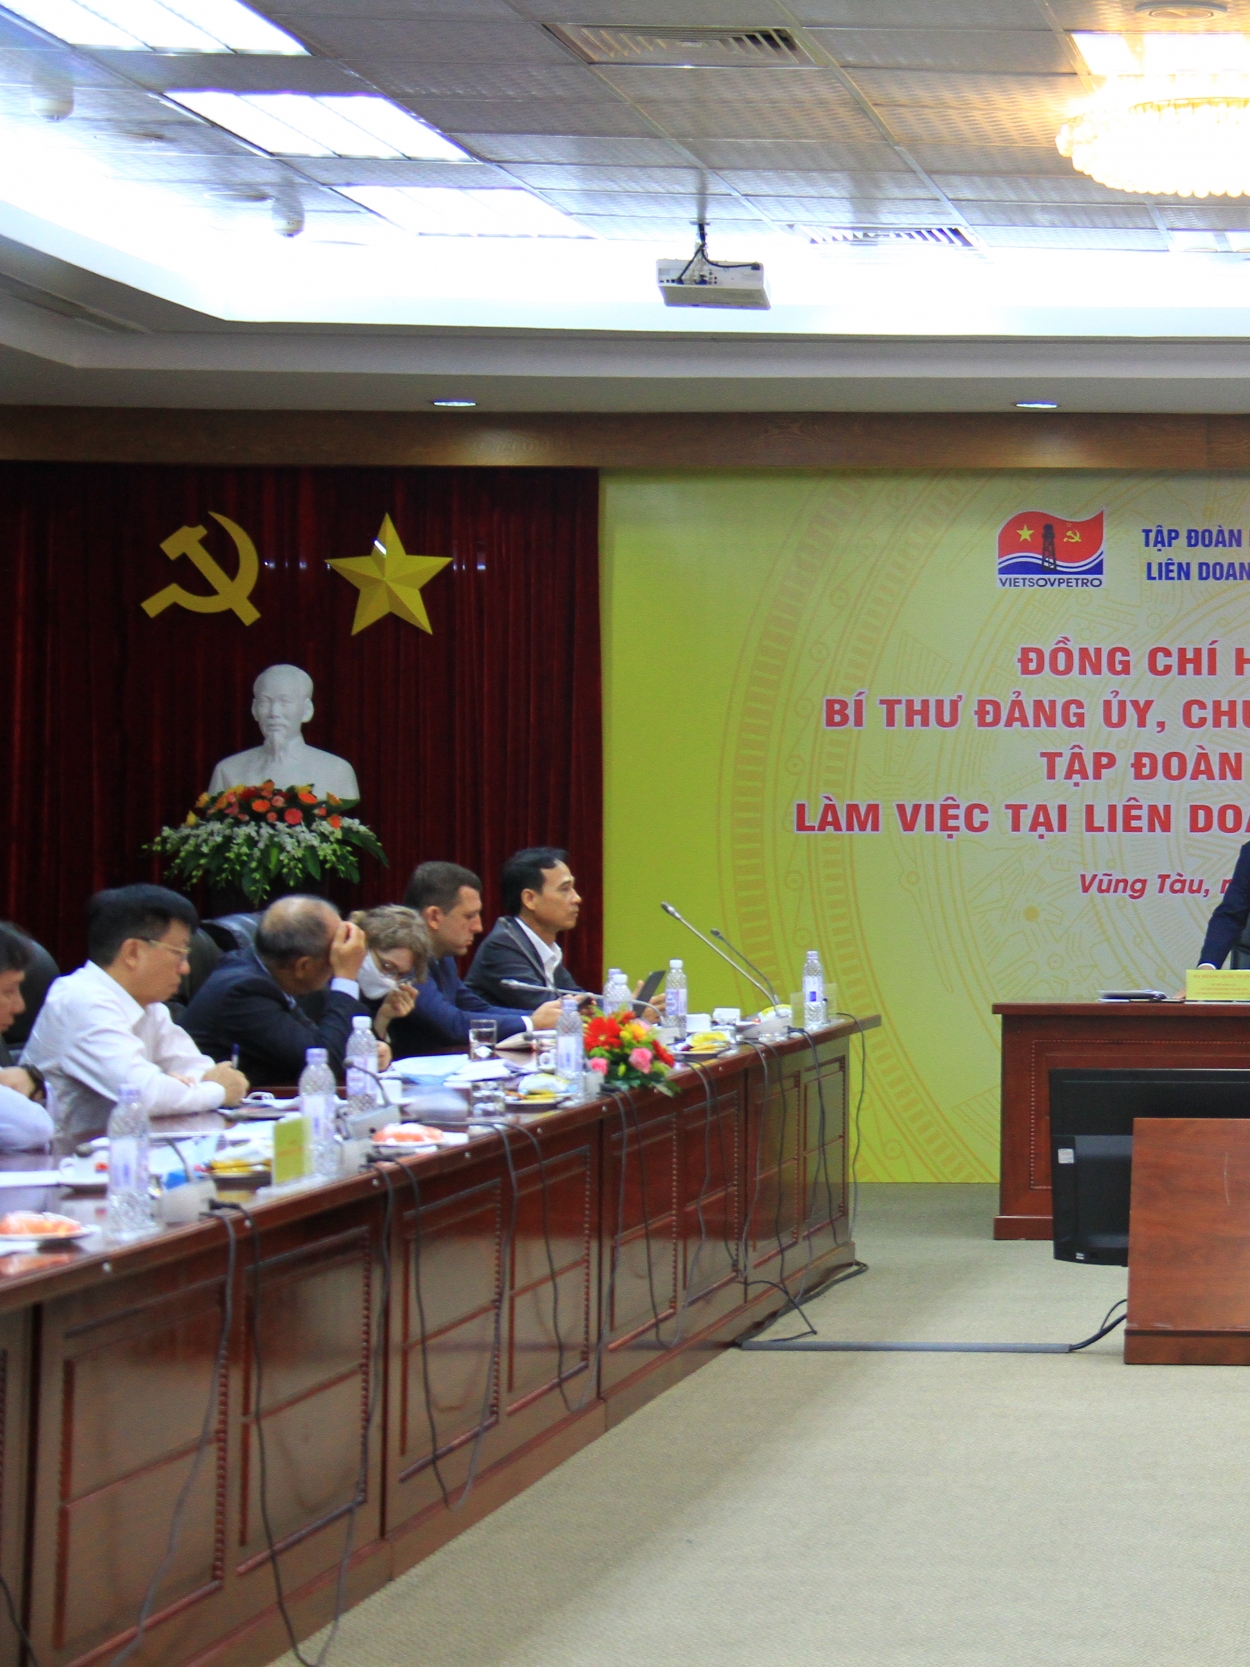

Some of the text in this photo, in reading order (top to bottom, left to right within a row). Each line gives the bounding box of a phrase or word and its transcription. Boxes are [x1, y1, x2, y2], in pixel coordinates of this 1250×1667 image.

[1142, 525, 1180, 552] TẬP
[1186, 524, 1242, 548] ĐOÀN
[999, 577, 1103, 588] VIETSOVPETRO
[1146, 558, 1191, 581] LIÊN
[1018, 636, 1130, 676] ĐỒNG
[1148, 640, 1217, 676] CHÍ
[825, 691, 864, 728] BÍ
[880, 695, 962, 728] THƯ
[975, 691, 1085, 728] ĐẢNG
[1103, 690, 1166, 733] ỦY,
[1041, 745, 1117, 787] TẬP
[1131, 745, 1242, 780] ĐOÀN
[796, 795, 880, 831] LÀM
[897, 797, 989, 838] VIỆC
[1005, 804, 1067, 838] TẠI
[1085, 797, 1171, 832] LIÊN
[1081, 872, 1147, 899] Vũng
[1158, 872, 1210, 897] Tàu,
